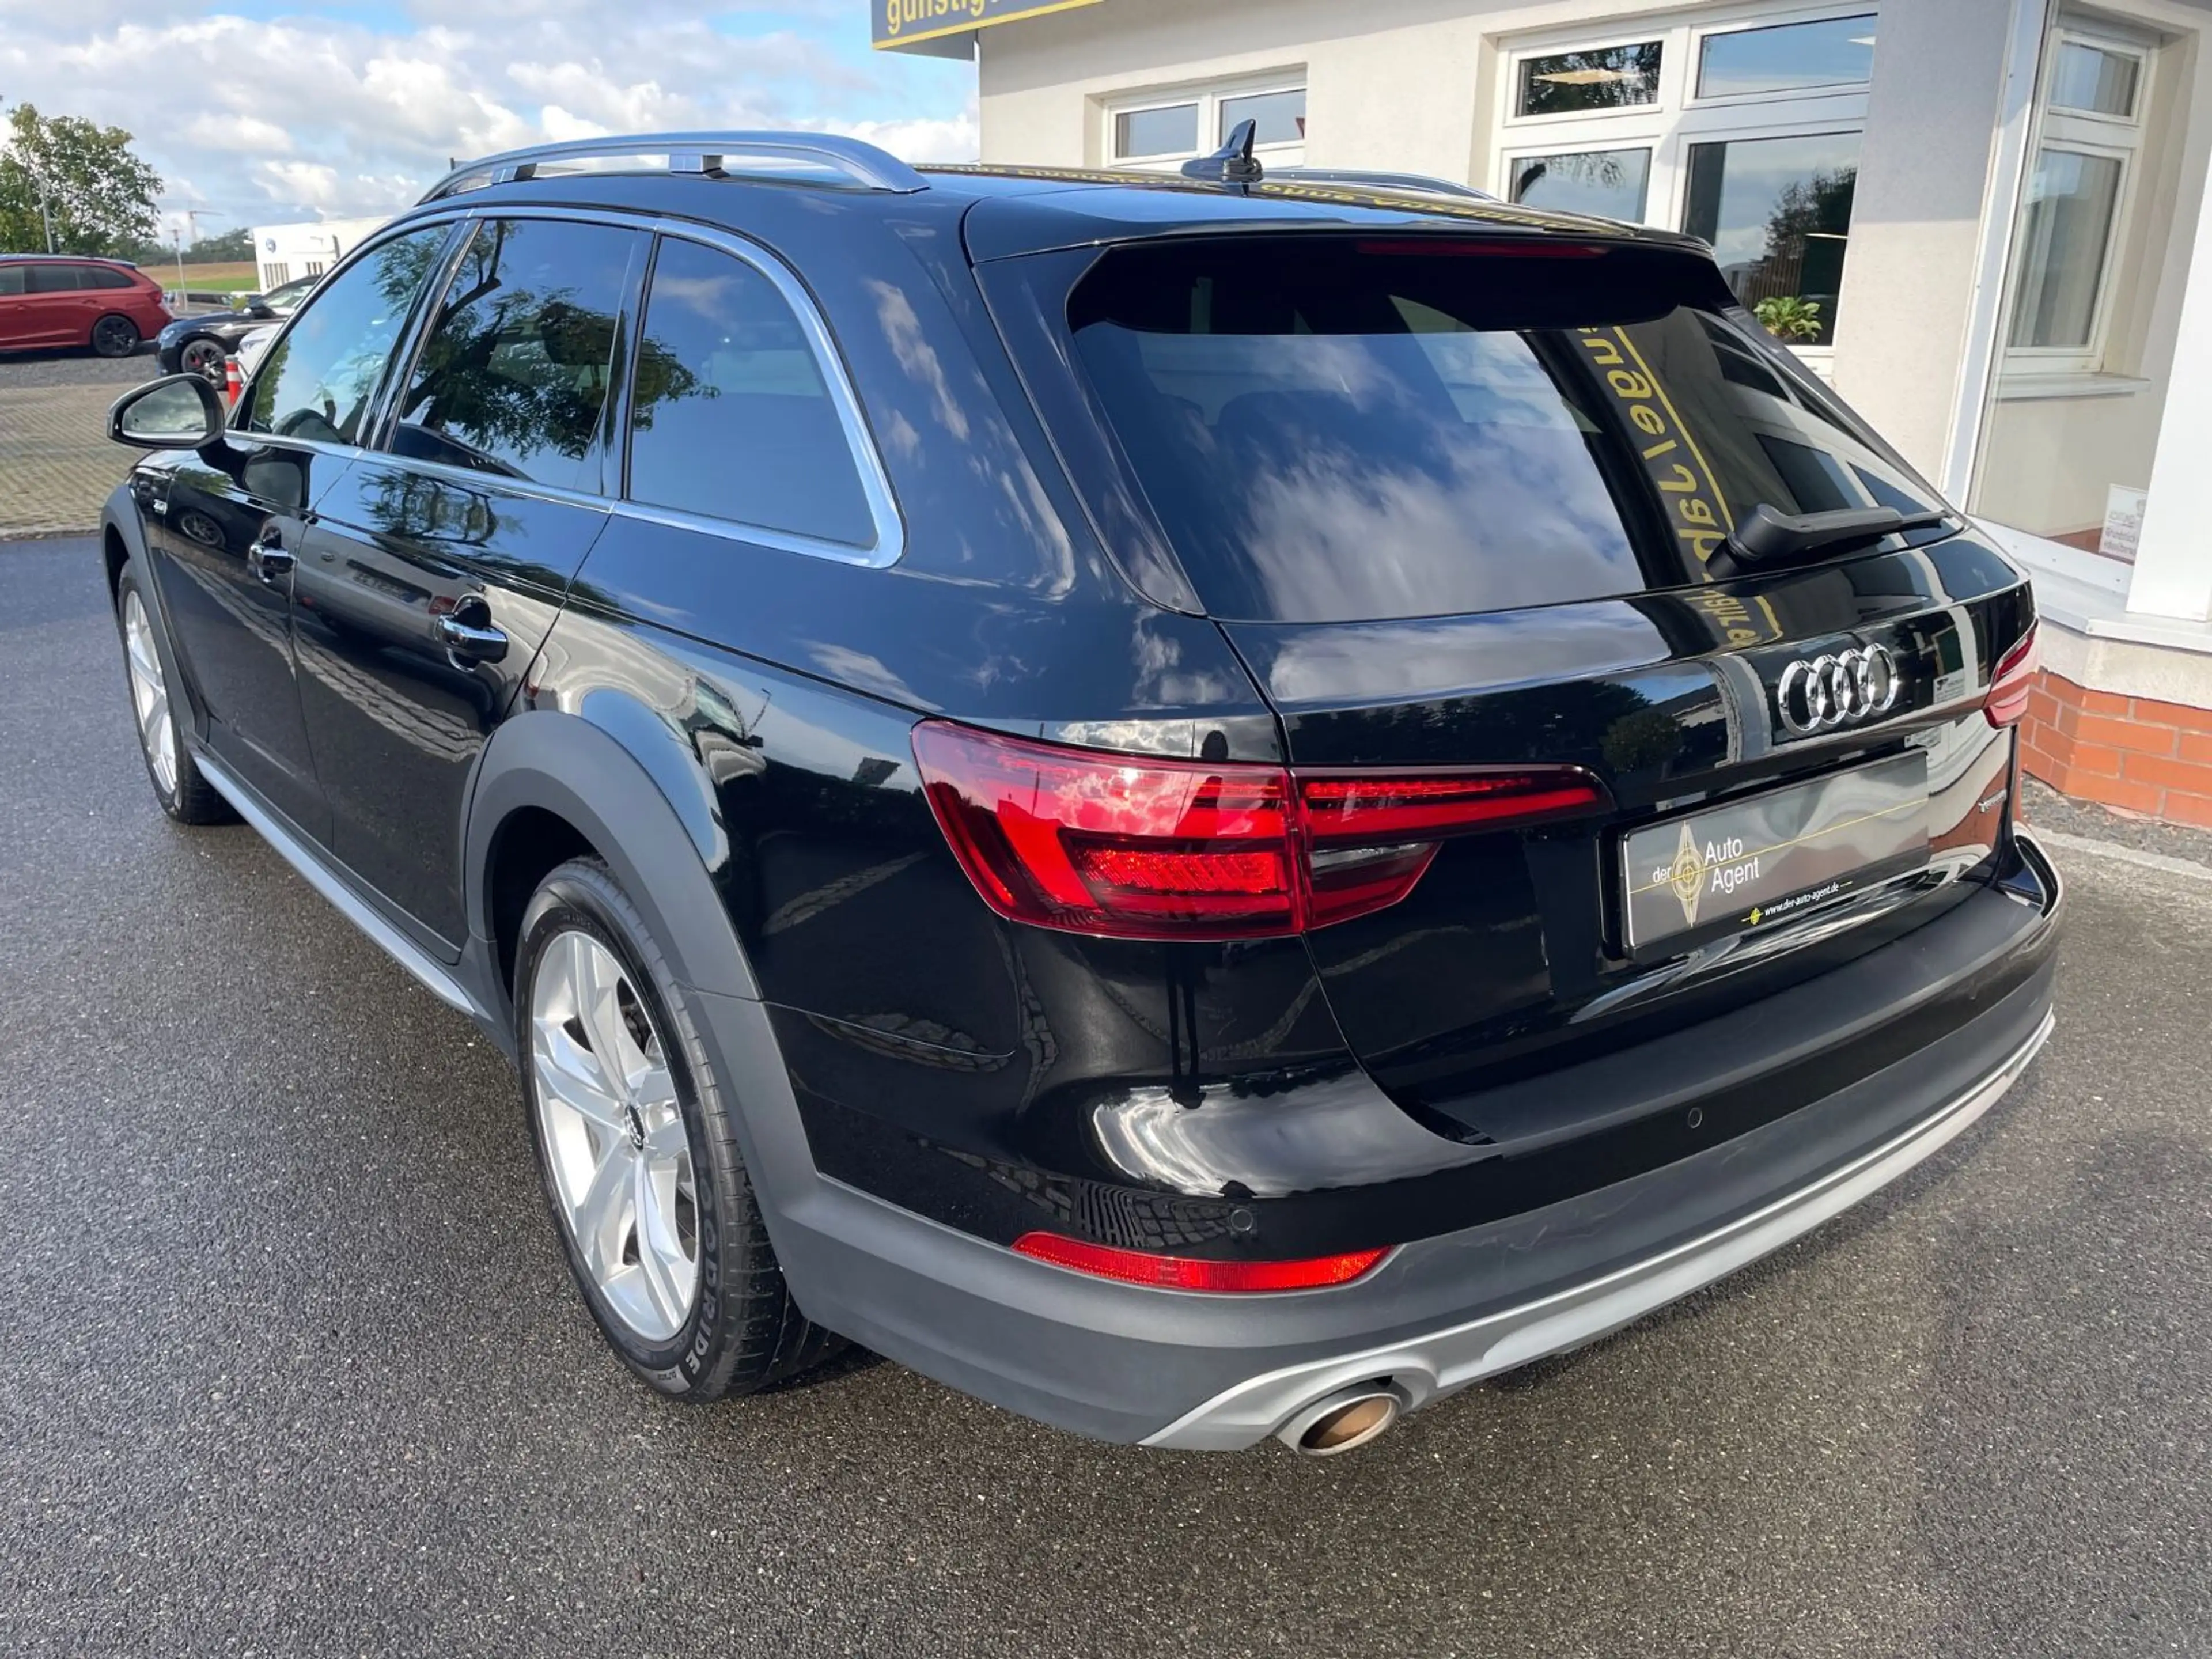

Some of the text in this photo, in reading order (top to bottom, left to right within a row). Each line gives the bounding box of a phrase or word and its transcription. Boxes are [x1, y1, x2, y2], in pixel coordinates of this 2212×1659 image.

[1705, 836, 1743, 866] Auto
[1653, 866, 1673, 883] der
[1711, 857, 1759, 894] Agent
[1764, 882, 1840, 916] www.der-auto-agent.de
[685, 1176, 719, 1376] OODRIDE
